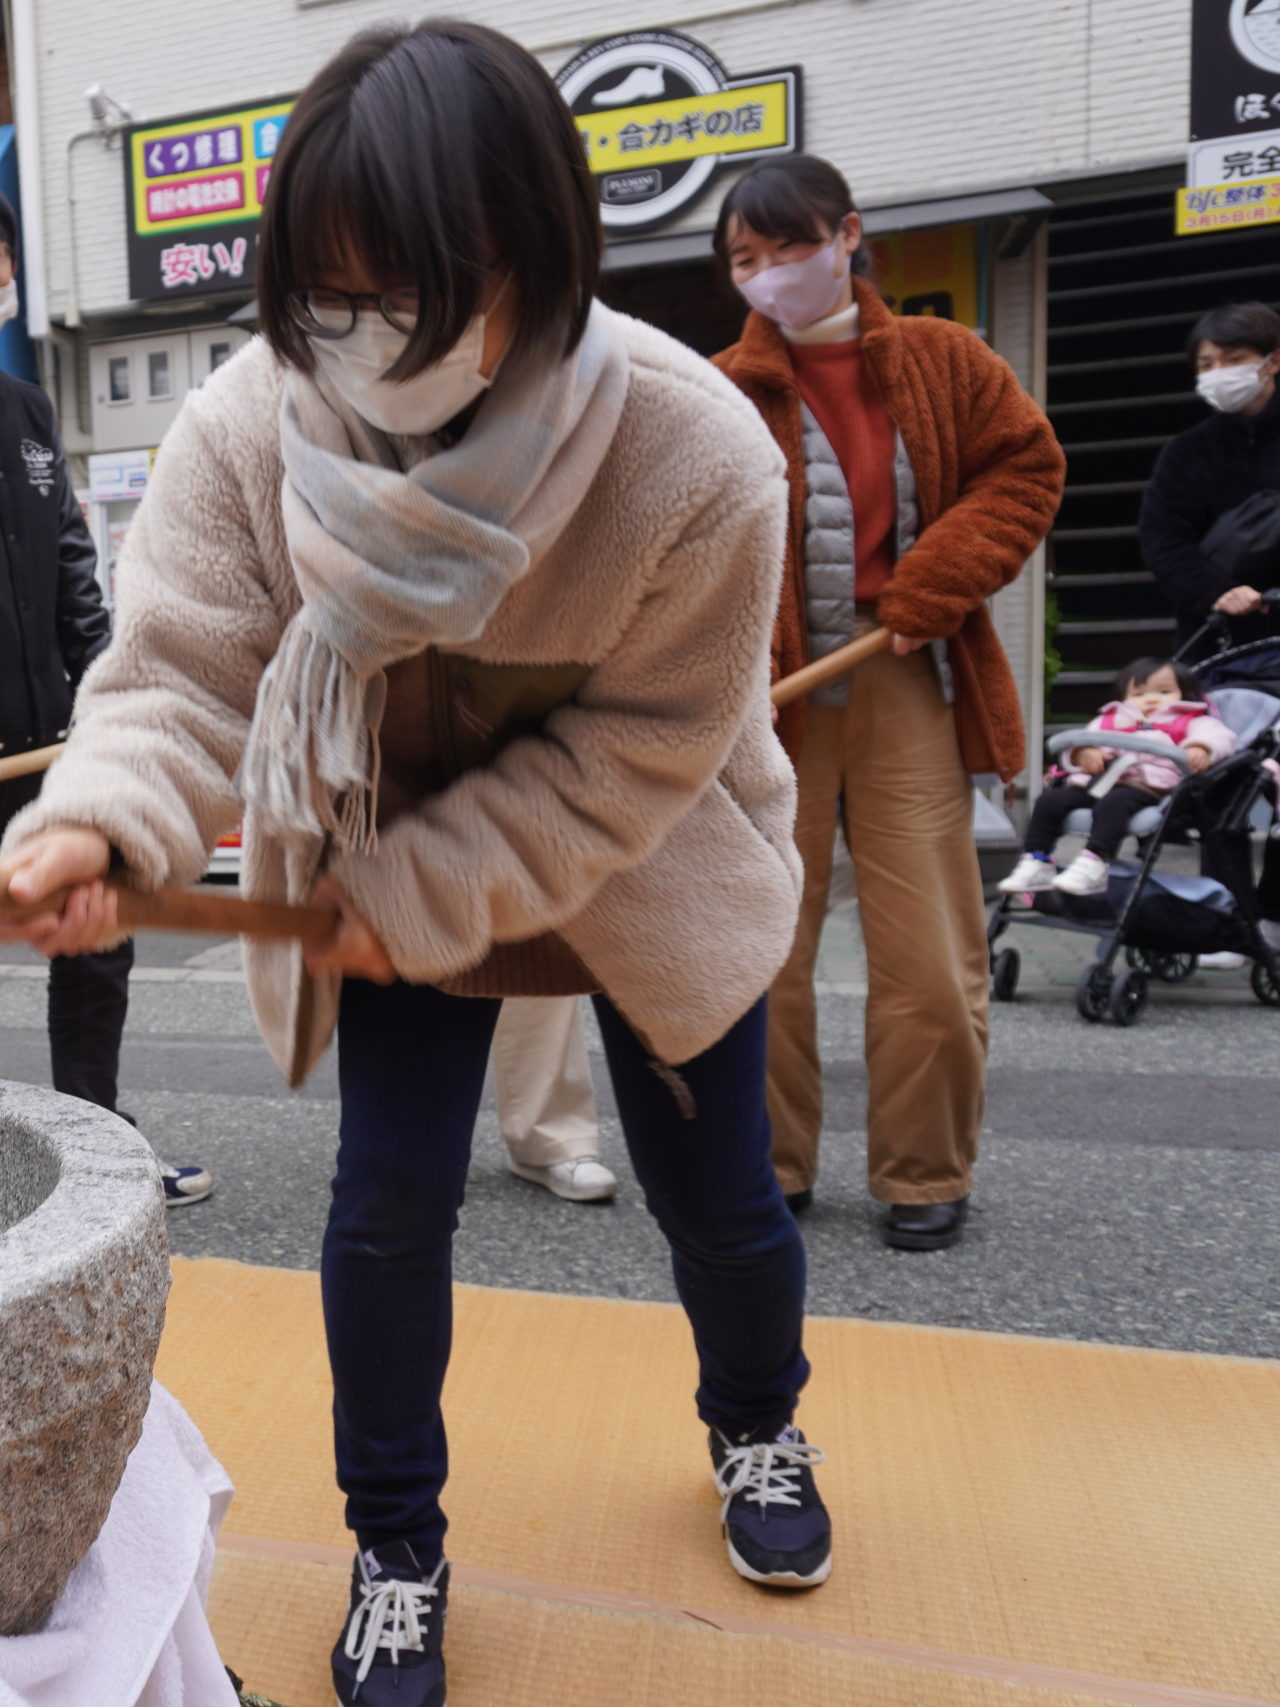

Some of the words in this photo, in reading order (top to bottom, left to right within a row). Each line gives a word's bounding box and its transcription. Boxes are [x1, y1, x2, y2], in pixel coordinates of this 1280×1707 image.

[583, 102, 765, 157] ・合カギの店
